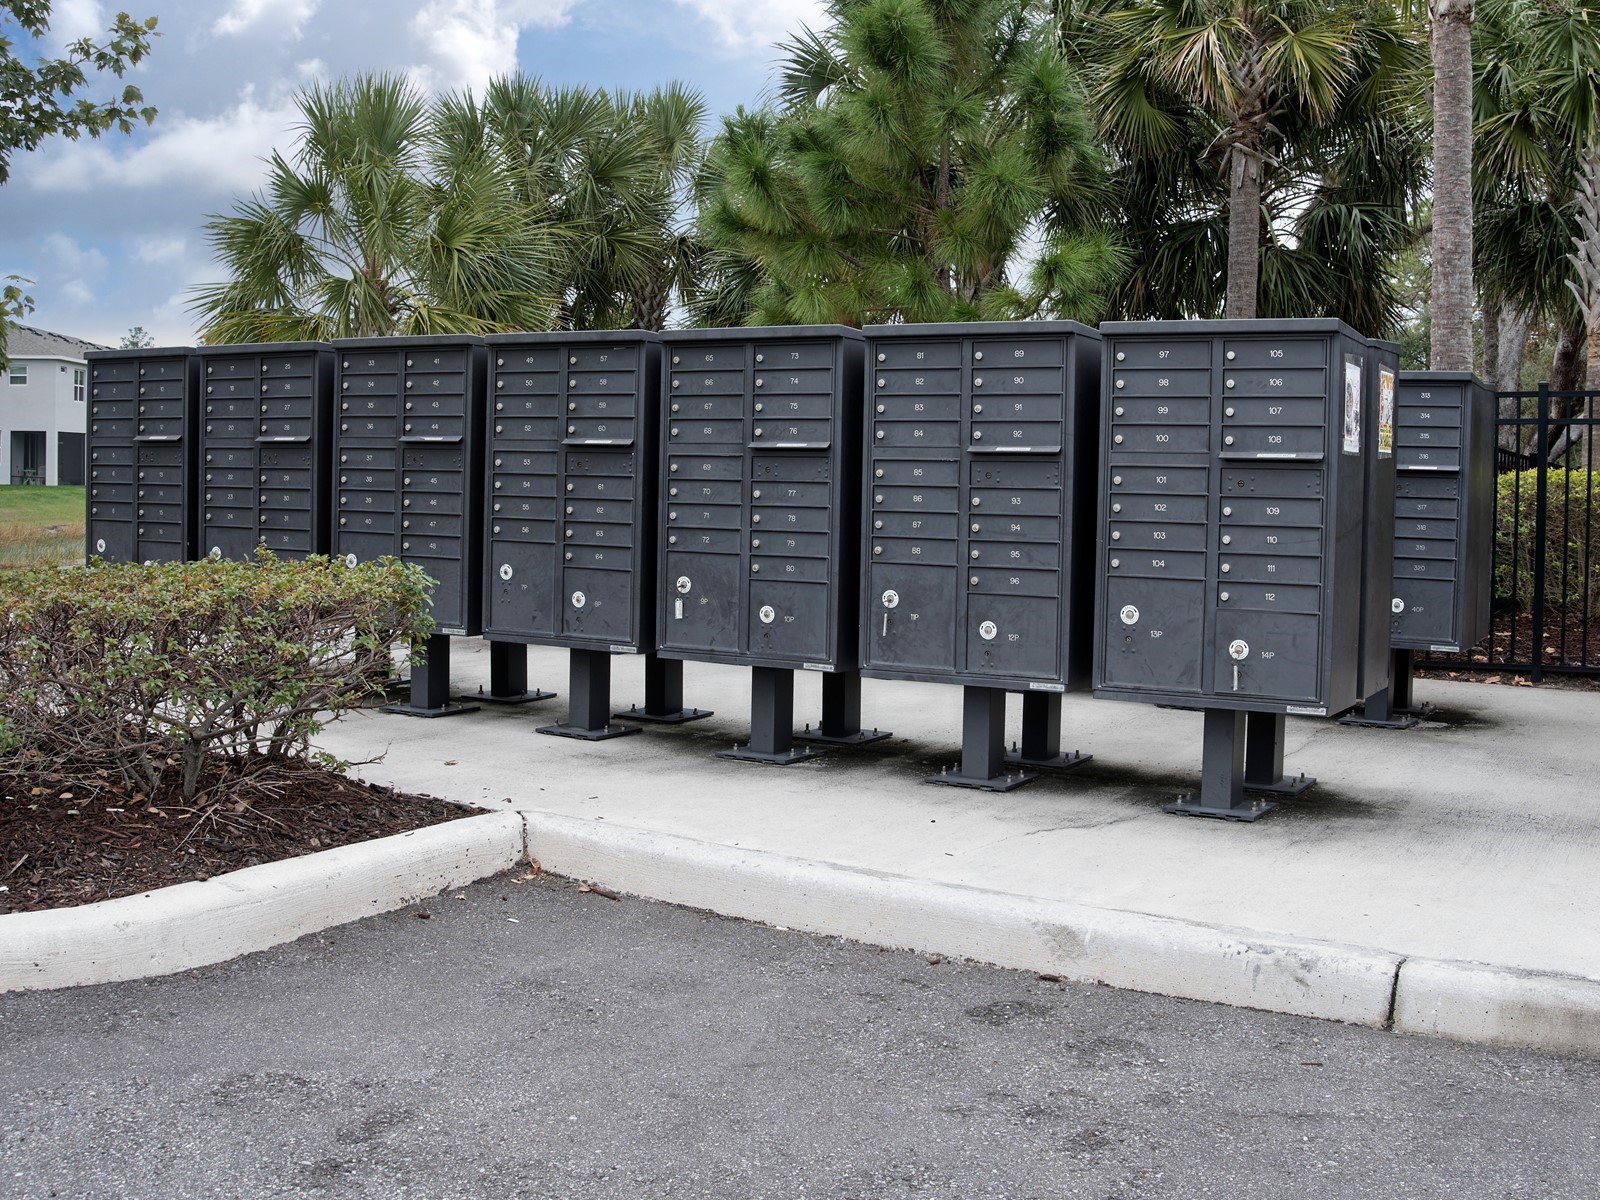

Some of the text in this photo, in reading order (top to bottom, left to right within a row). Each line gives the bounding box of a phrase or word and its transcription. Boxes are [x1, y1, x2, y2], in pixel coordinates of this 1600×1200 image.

[705, 354, 714, 362] 65
[790, 352, 800, 360] 73
[916, 351, 924, 360] 81
[1014, 349, 1025, 358] 89
[1158, 350, 1170, 359] 97
[1269, 349, 1284, 358] 105
[599, 378, 608, 386] 58
[704, 378, 714, 386] 66
[914, 377, 925, 386] 82
[1013, 376, 1025, 385] 90
[1158, 378, 1170, 387] 98
[1269, 378, 1283, 387] 106
[598, 401, 607, 409] 59
[704, 402, 713, 410] 67
[789, 402, 799, 410] 75
[914, 403, 924, 412] 83
[1014, 403, 1023, 411] 91
[1157, 406, 1169, 415] 99
[1268, 406, 1283, 415] 107
[524, 424, 532, 432] 52
[703, 427, 712, 435] 68
[789, 427, 798, 435] 76
[913, 429, 924, 438] 84
[1012, 430, 1023, 438] 92
[1155, 434, 1170, 443] 100
[1268, 435, 1282, 444] 108
[702, 463, 712, 471] 69
[913, 468, 923, 476] 85
[1156, 475, 1167, 484] 101
[702, 487, 711, 495] 70
[787, 489, 797, 497] 77
[912, 494, 923, 503] 86
[1011, 497, 1022, 505] 93
[522, 503, 530, 511] 55
[596, 506, 604, 514] 62
[1154, 503, 1167, 512] 102
[1266, 506, 1280, 516] 109
[787, 514, 797, 523] 78
[912, 520, 922, 529] 87
[1010, 523, 1021, 532] 94
[521, 526, 530, 534] 56
[701, 536, 710, 544] 72
[1152, 531, 1166, 540] 103
[1266, 535, 1278, 544] 110
[786, 539, 796, 548] 79
[911, 546, 921, 555] 88
[1010, 550, 1021, 559] 95
[1152, 559, 1165, 568] 104
[1267, 564, 1276, 572] 111
[785, 564, 796, 573] 80
[1009, 576, 1020, 585] 96
[1265, 592, 1276, 601] 112
[910, 613, 920, 621] 11P
[1007, 633, 1020, 642] 12P
[1150, 630, 1163, 639] 13P
[1261, 651, 1275, 660] 14P
